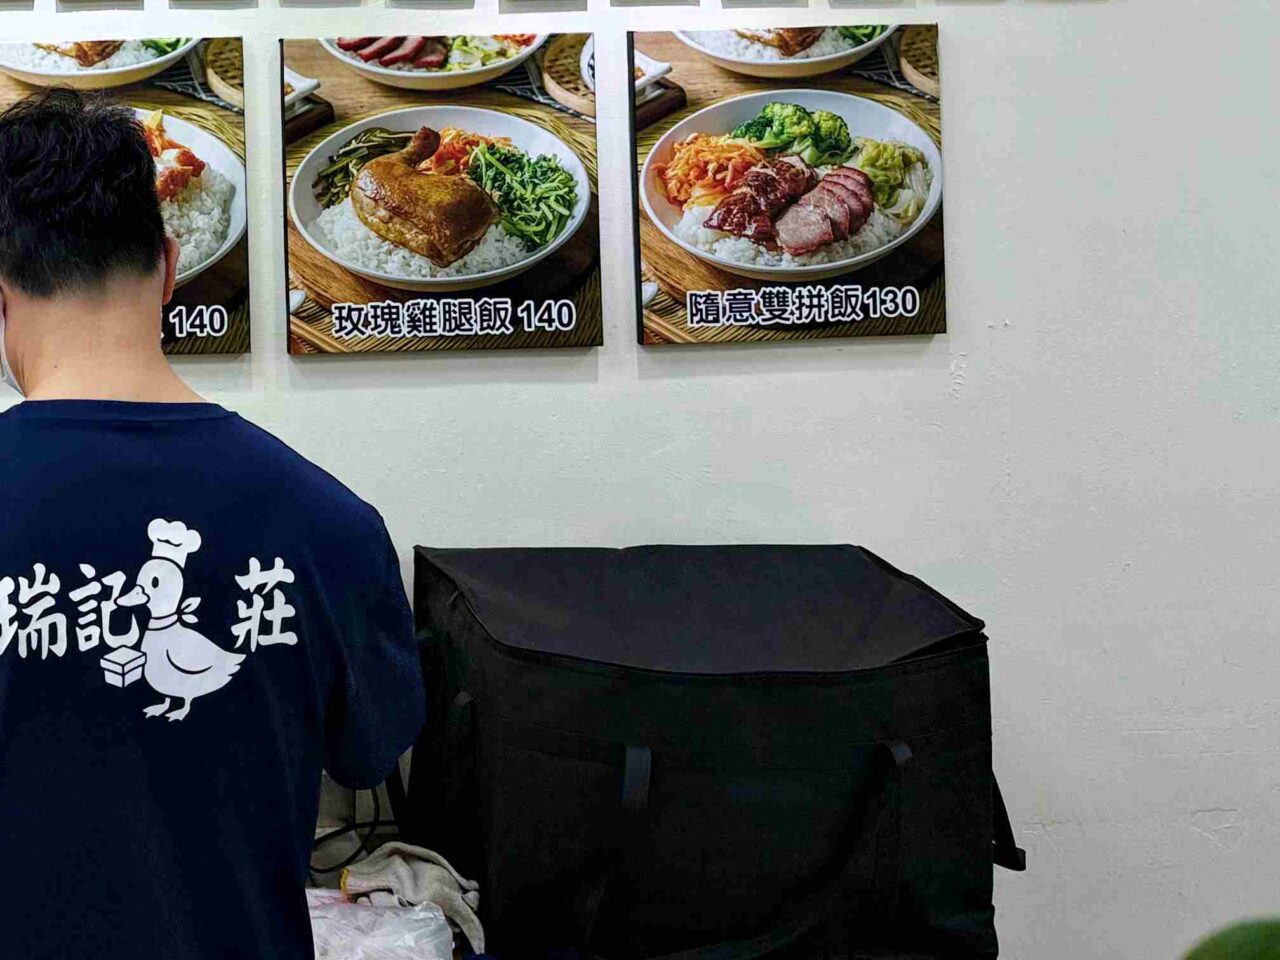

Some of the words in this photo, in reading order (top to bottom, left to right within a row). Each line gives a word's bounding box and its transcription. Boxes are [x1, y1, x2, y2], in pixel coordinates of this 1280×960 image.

[170, 305, 228, 338] 140
[331, 298, 514, 338] 玫瑰雞腿飯
[517, 299, 577, 331] 140
[231, 557, 298, 652] 莊
